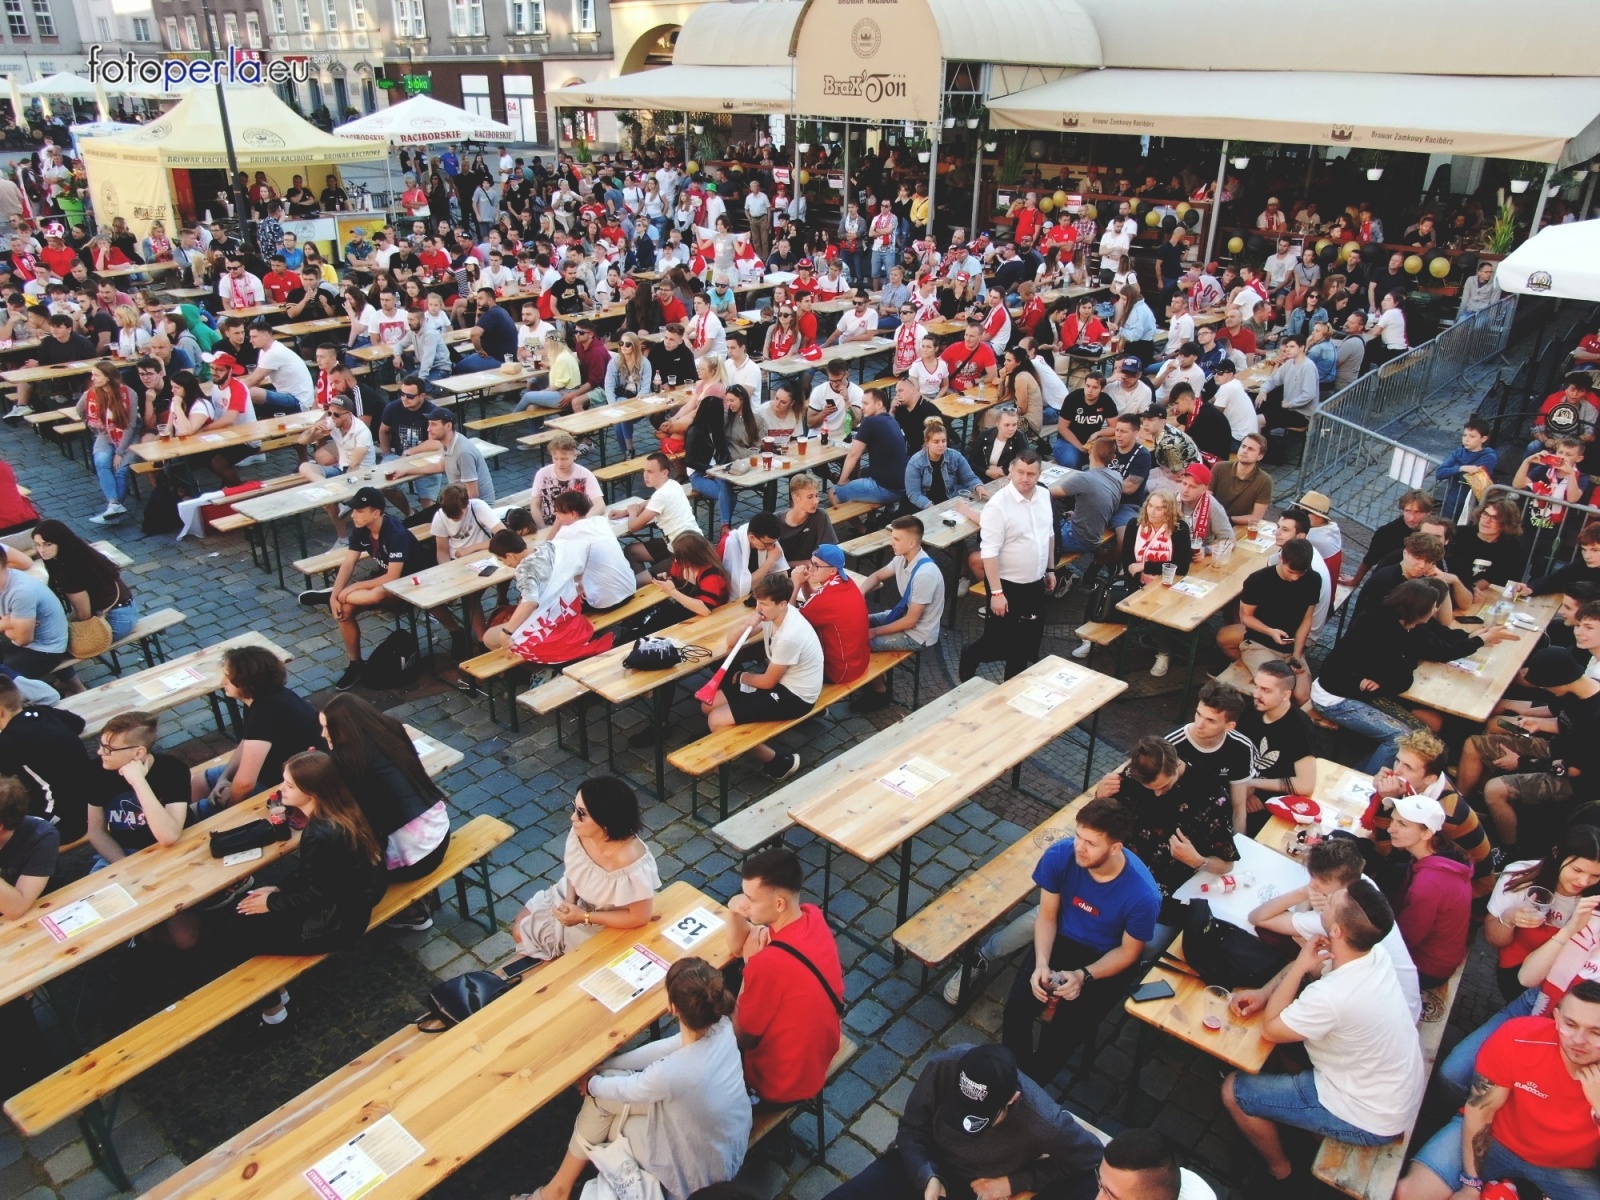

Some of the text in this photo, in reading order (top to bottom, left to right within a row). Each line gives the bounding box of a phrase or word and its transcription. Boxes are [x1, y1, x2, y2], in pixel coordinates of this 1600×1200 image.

[400, 130, 461, 143] RACIBORSKIE
[474, 130, 512, 139] RACIBORSKIE
[1371, 131, 1393, 140] Browar
[1394, 133, 1424, 144] Zamkowy
[1425, 135, 1454, 145] Racibórz
[167, 155, 200, 164] BROWAR
[1057, 671, 1079, 684] 25
[109, 808, 147, 826] NAS
[1078, 902, 1093, 913] chill
[676, 915, 710, 937] 13
